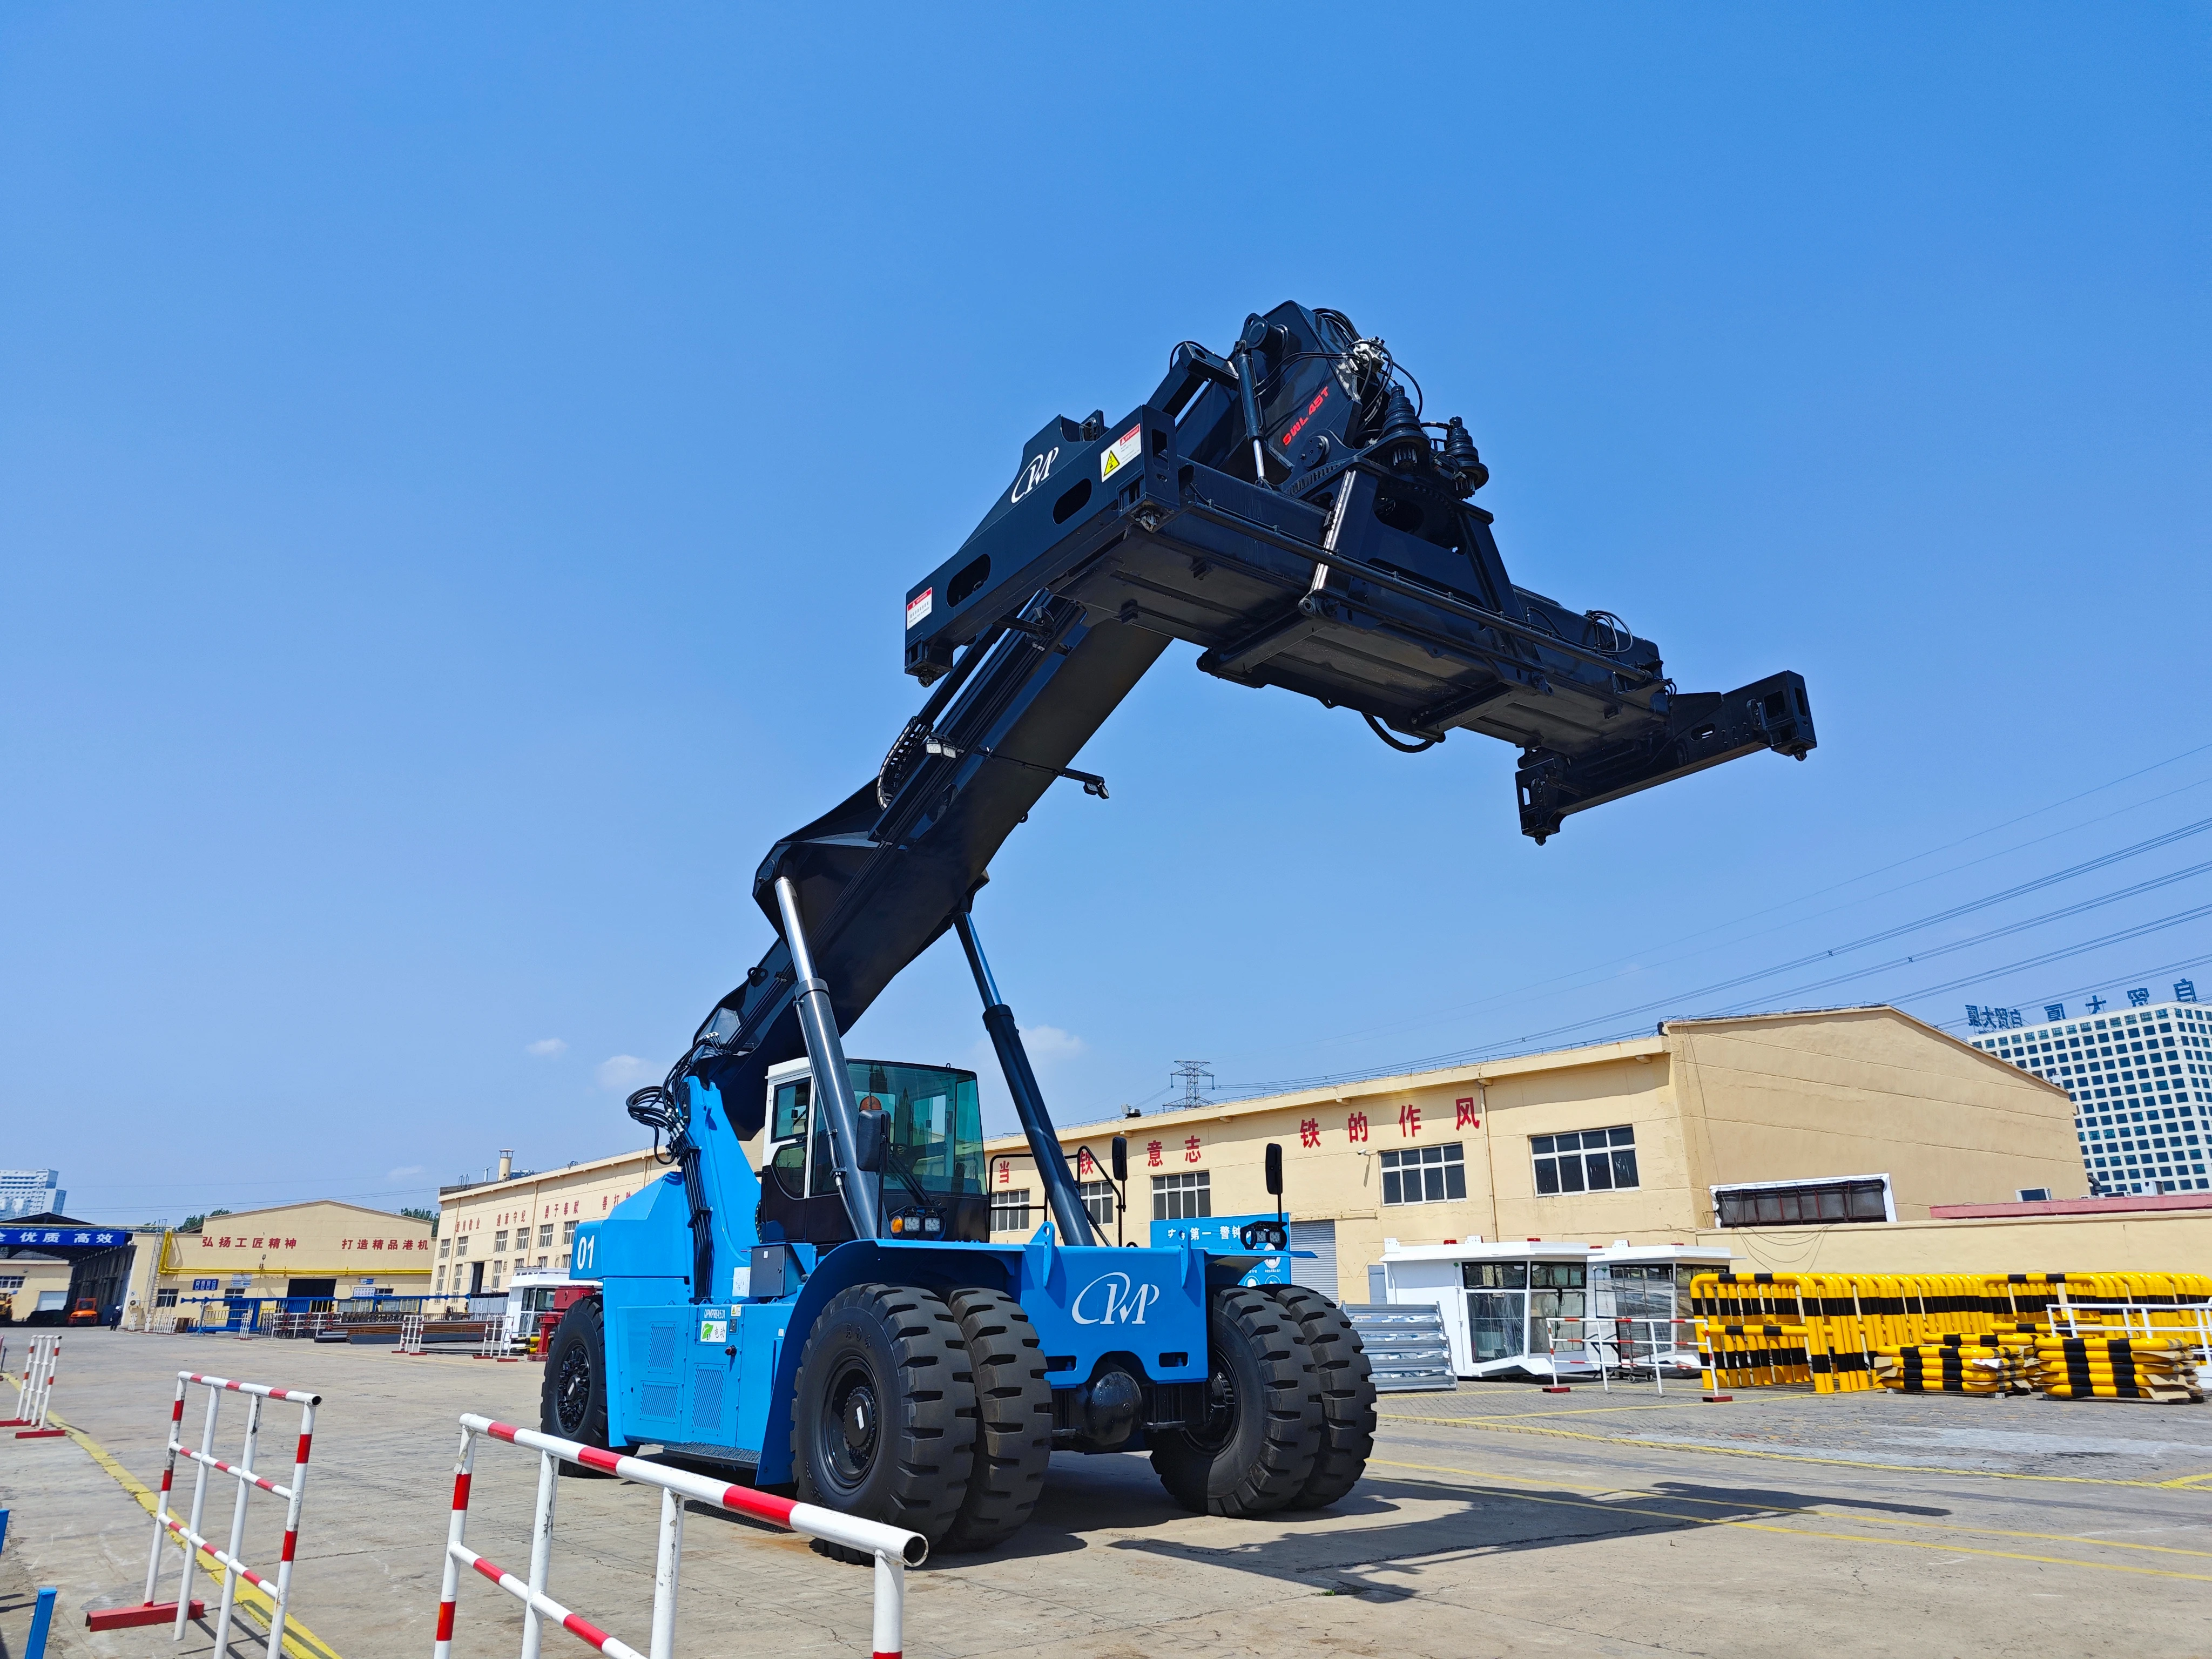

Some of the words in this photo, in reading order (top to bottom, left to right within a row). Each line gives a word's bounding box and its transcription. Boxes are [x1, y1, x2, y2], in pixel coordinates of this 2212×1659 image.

[1282, 417, 1309, 446] SWL
[1309, 386, 1328, 416] 45T
[1300, 1097, 1480, 1149] 铁的作风
[999, 1161, 1010, 1184] 当
[19, 1232, 60, 1243] 优质
[73, 1232, 113, 1244] 高效
[1168, 1226, 1212, 1241] 安第一
[202, 1236, 297, 1249] 弘扬工匠精神
[341, 1239, 429, 1251] 打造精品港机
[577, 1235, 595, 1270] 01
[714, 1326, 725, 1339] 电动
